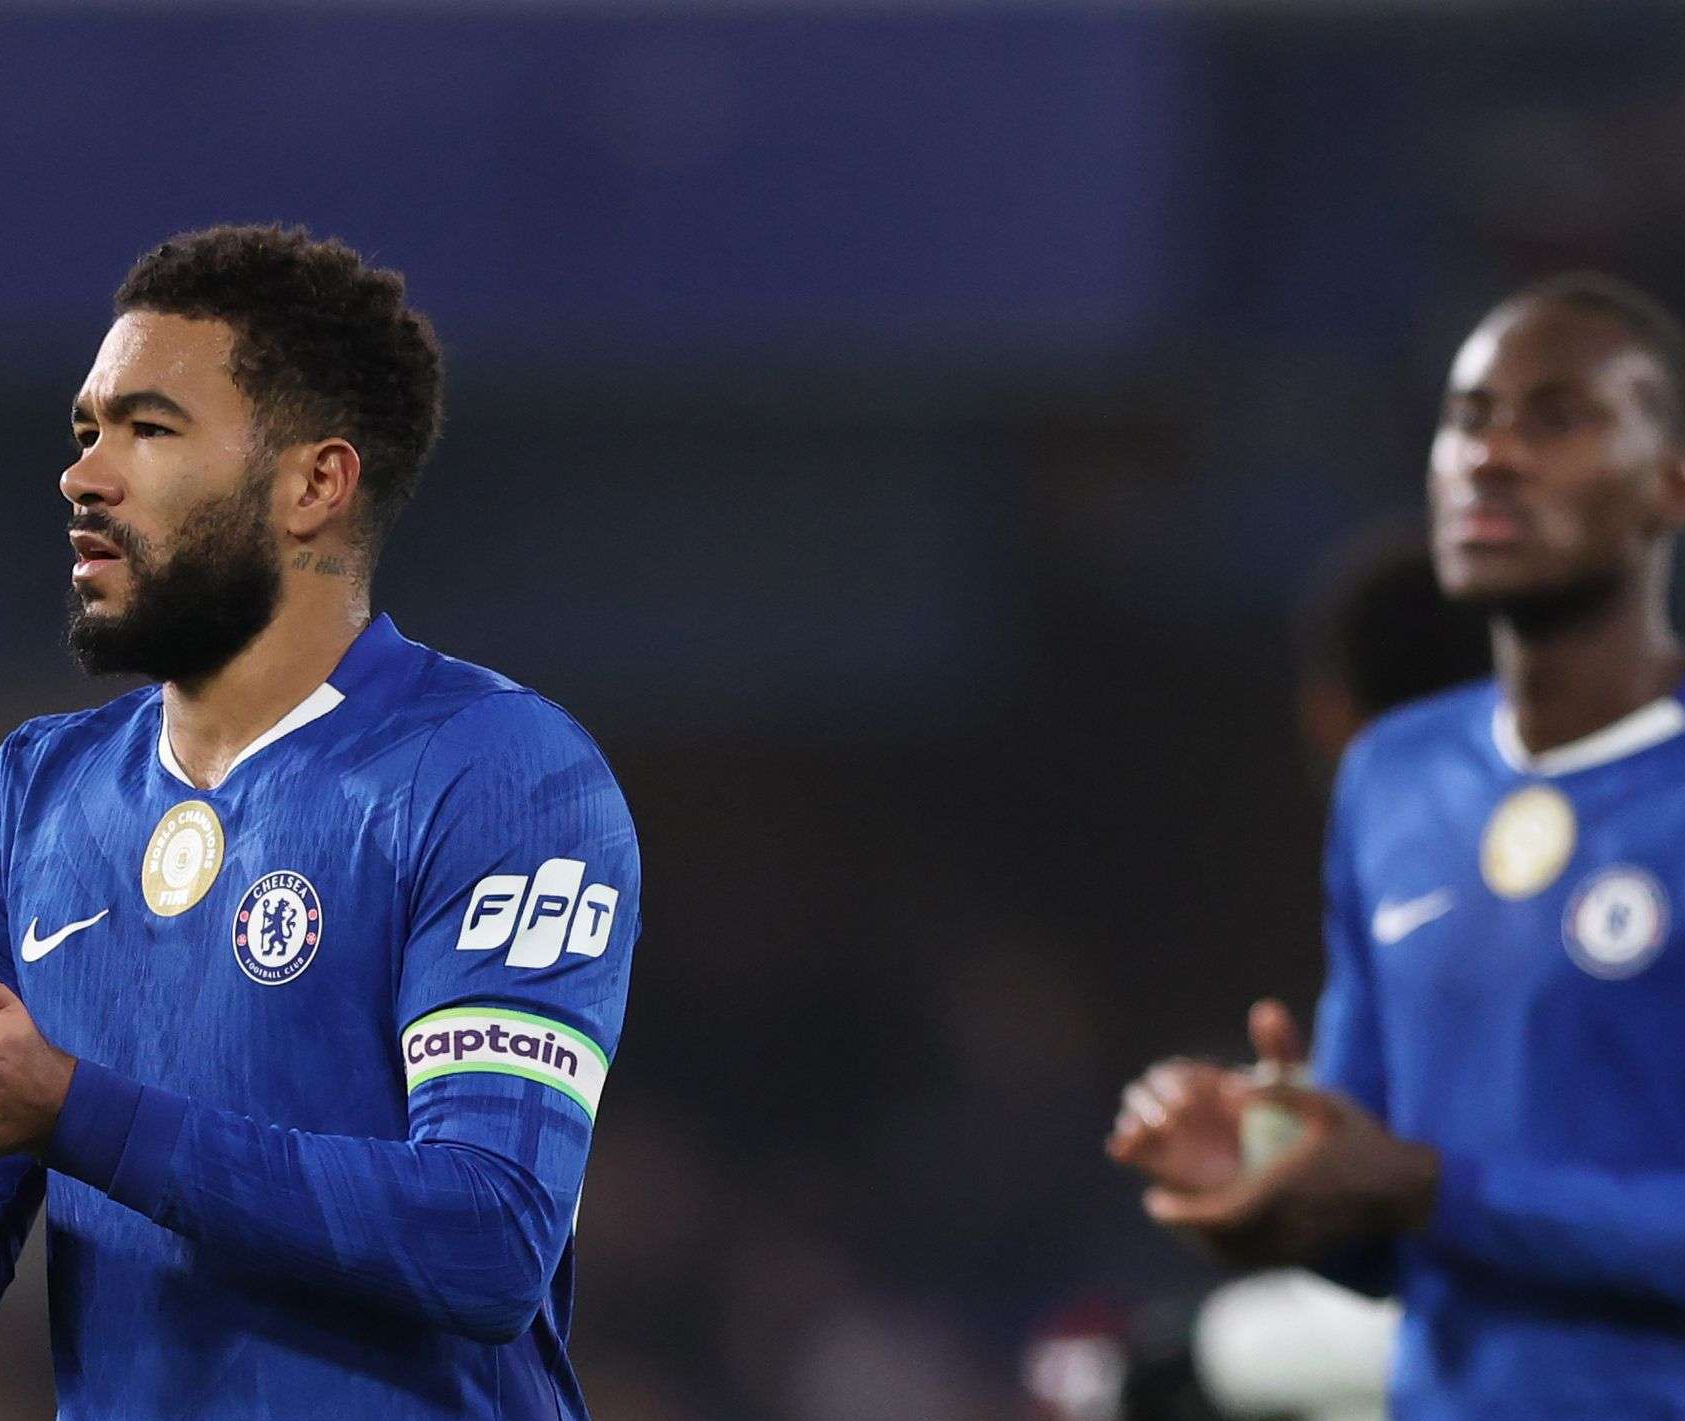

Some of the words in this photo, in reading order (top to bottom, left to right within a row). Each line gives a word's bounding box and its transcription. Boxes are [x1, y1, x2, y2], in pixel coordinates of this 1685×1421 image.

[149, 820, 176, 874] WORLD
[177, 810, 216, 870] CHAMPIONS
[253, 875, 308, 899] CHELSEA
[244, 958, 282, 979] FOOTBALL
[283, 957, 304, 975] CLUB
